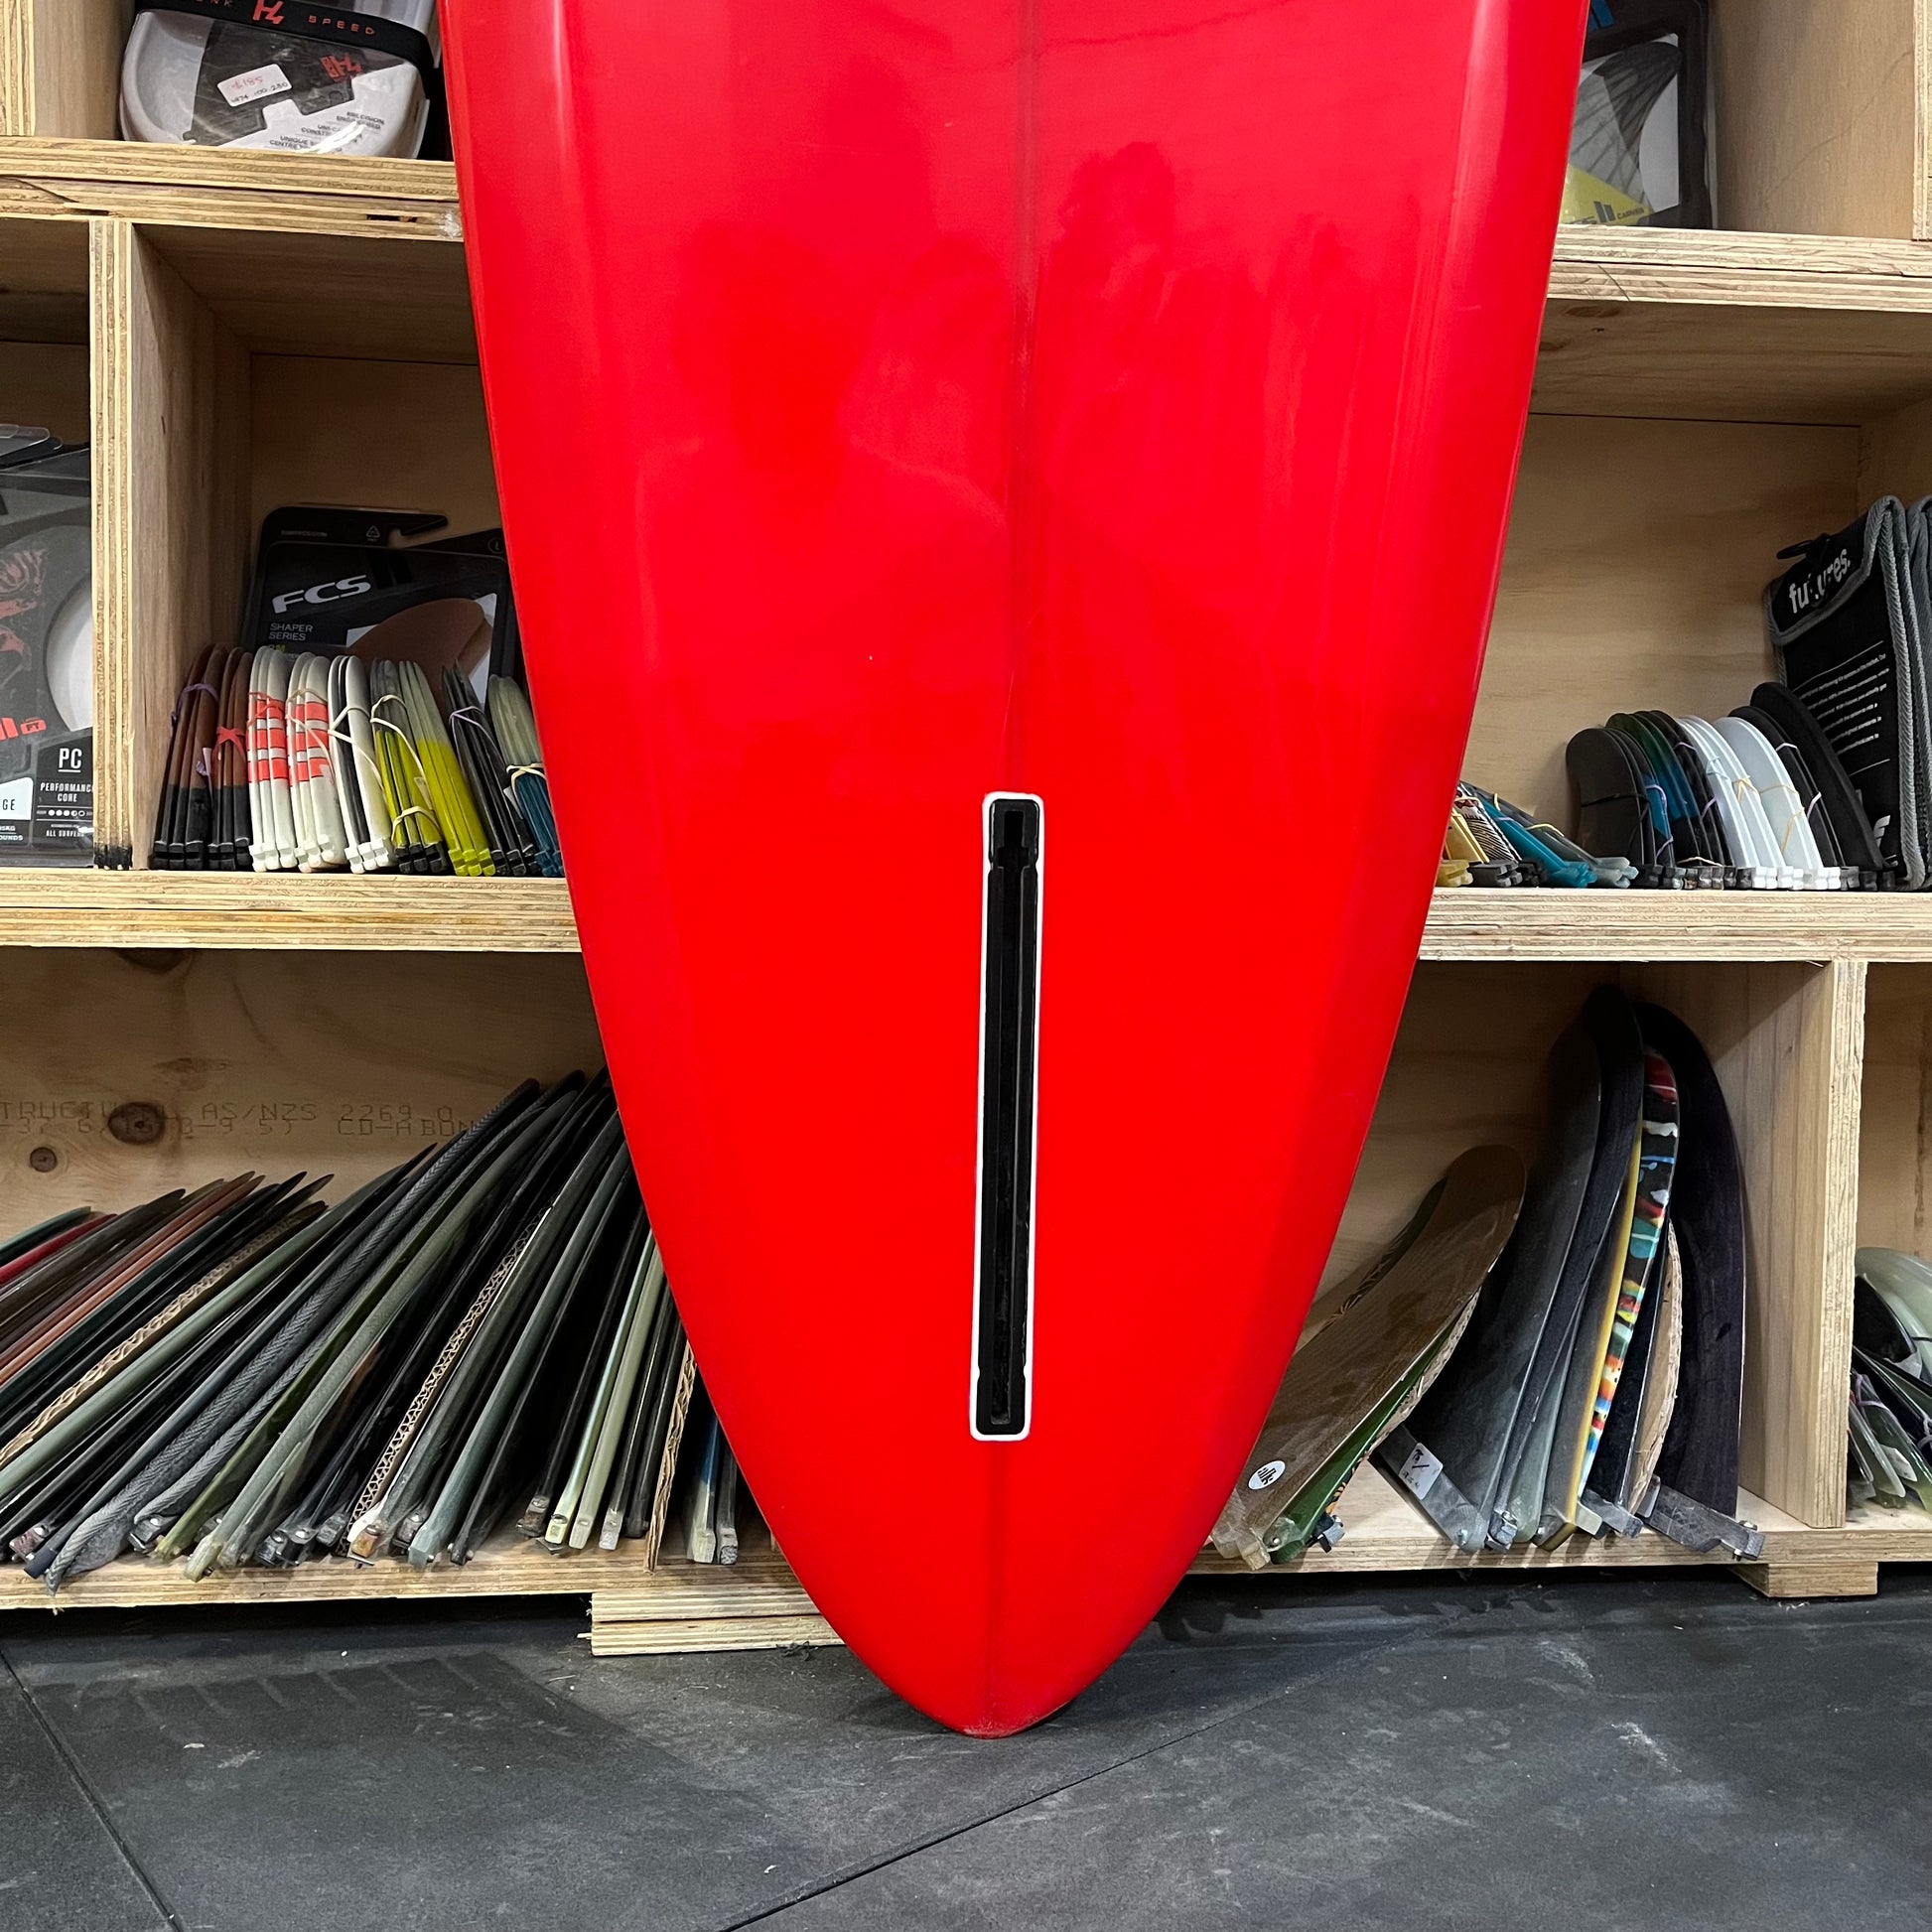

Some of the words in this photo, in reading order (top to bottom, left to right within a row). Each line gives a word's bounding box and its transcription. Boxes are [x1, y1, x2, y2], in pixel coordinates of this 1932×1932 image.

[308, 15, 376, 35] SPEED
[1789, 548, 1851, 615] fuues.
[272, 575, 371, 614] FCS
[268, 631, 307, 641] SERIES
[270, 622, 313, 633] SHAPER
[59, 748, 83, 769] PC
[40, 782, 93, 793] PERFORMANC
[2, 798, 16, 811] GE
[57, 793, 78, 803] CORE
[202, 1102, 317, 1121] AS/NZS
[340, 1104, 411, 1121] 2269
[421, 1120, 476, 1137] BON
